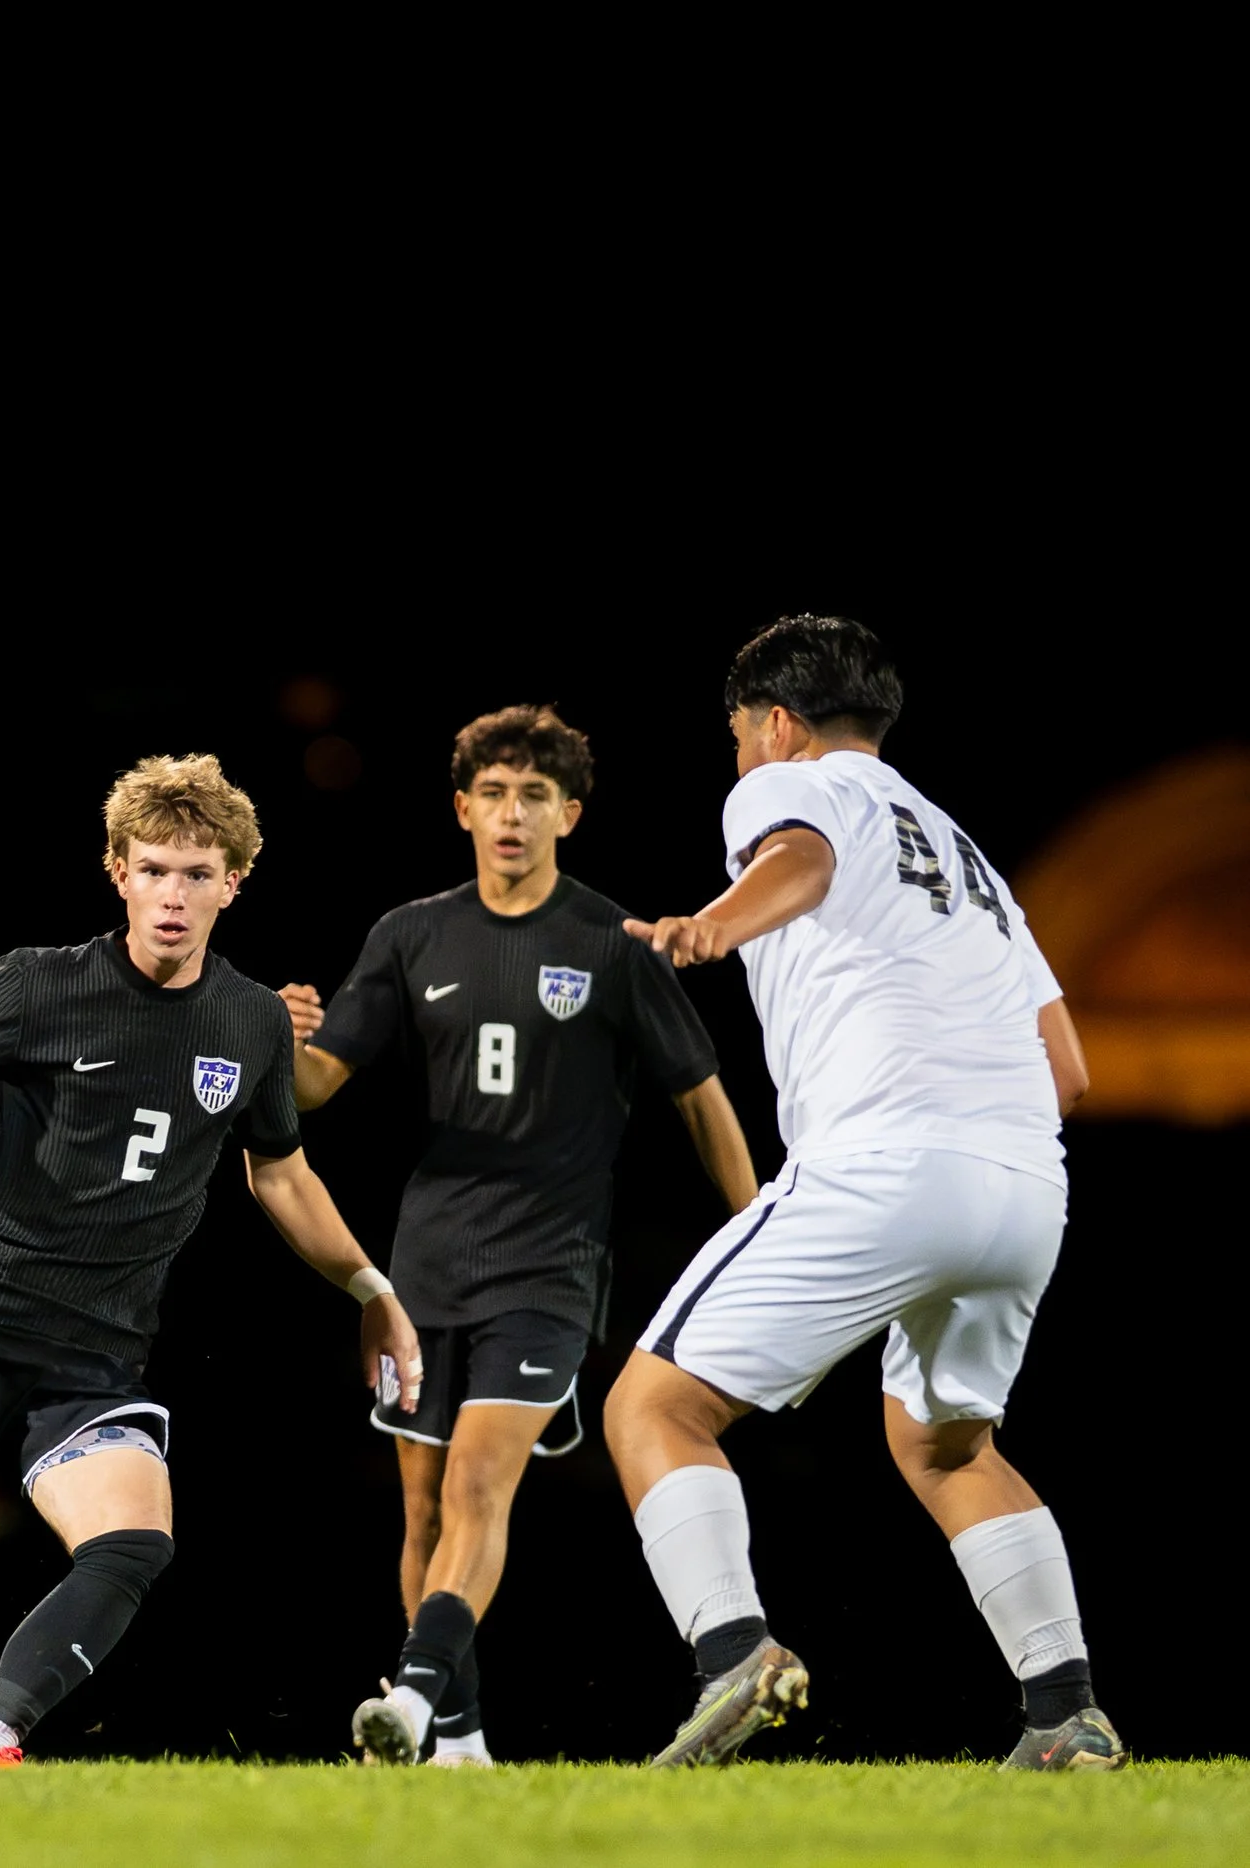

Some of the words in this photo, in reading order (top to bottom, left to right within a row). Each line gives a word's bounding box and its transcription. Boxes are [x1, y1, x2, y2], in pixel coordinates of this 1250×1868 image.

[889, 801, 1011, 941] 44
[477, 1023, 516, 1095] 8
[122, 1108, 171, 1182] 2
